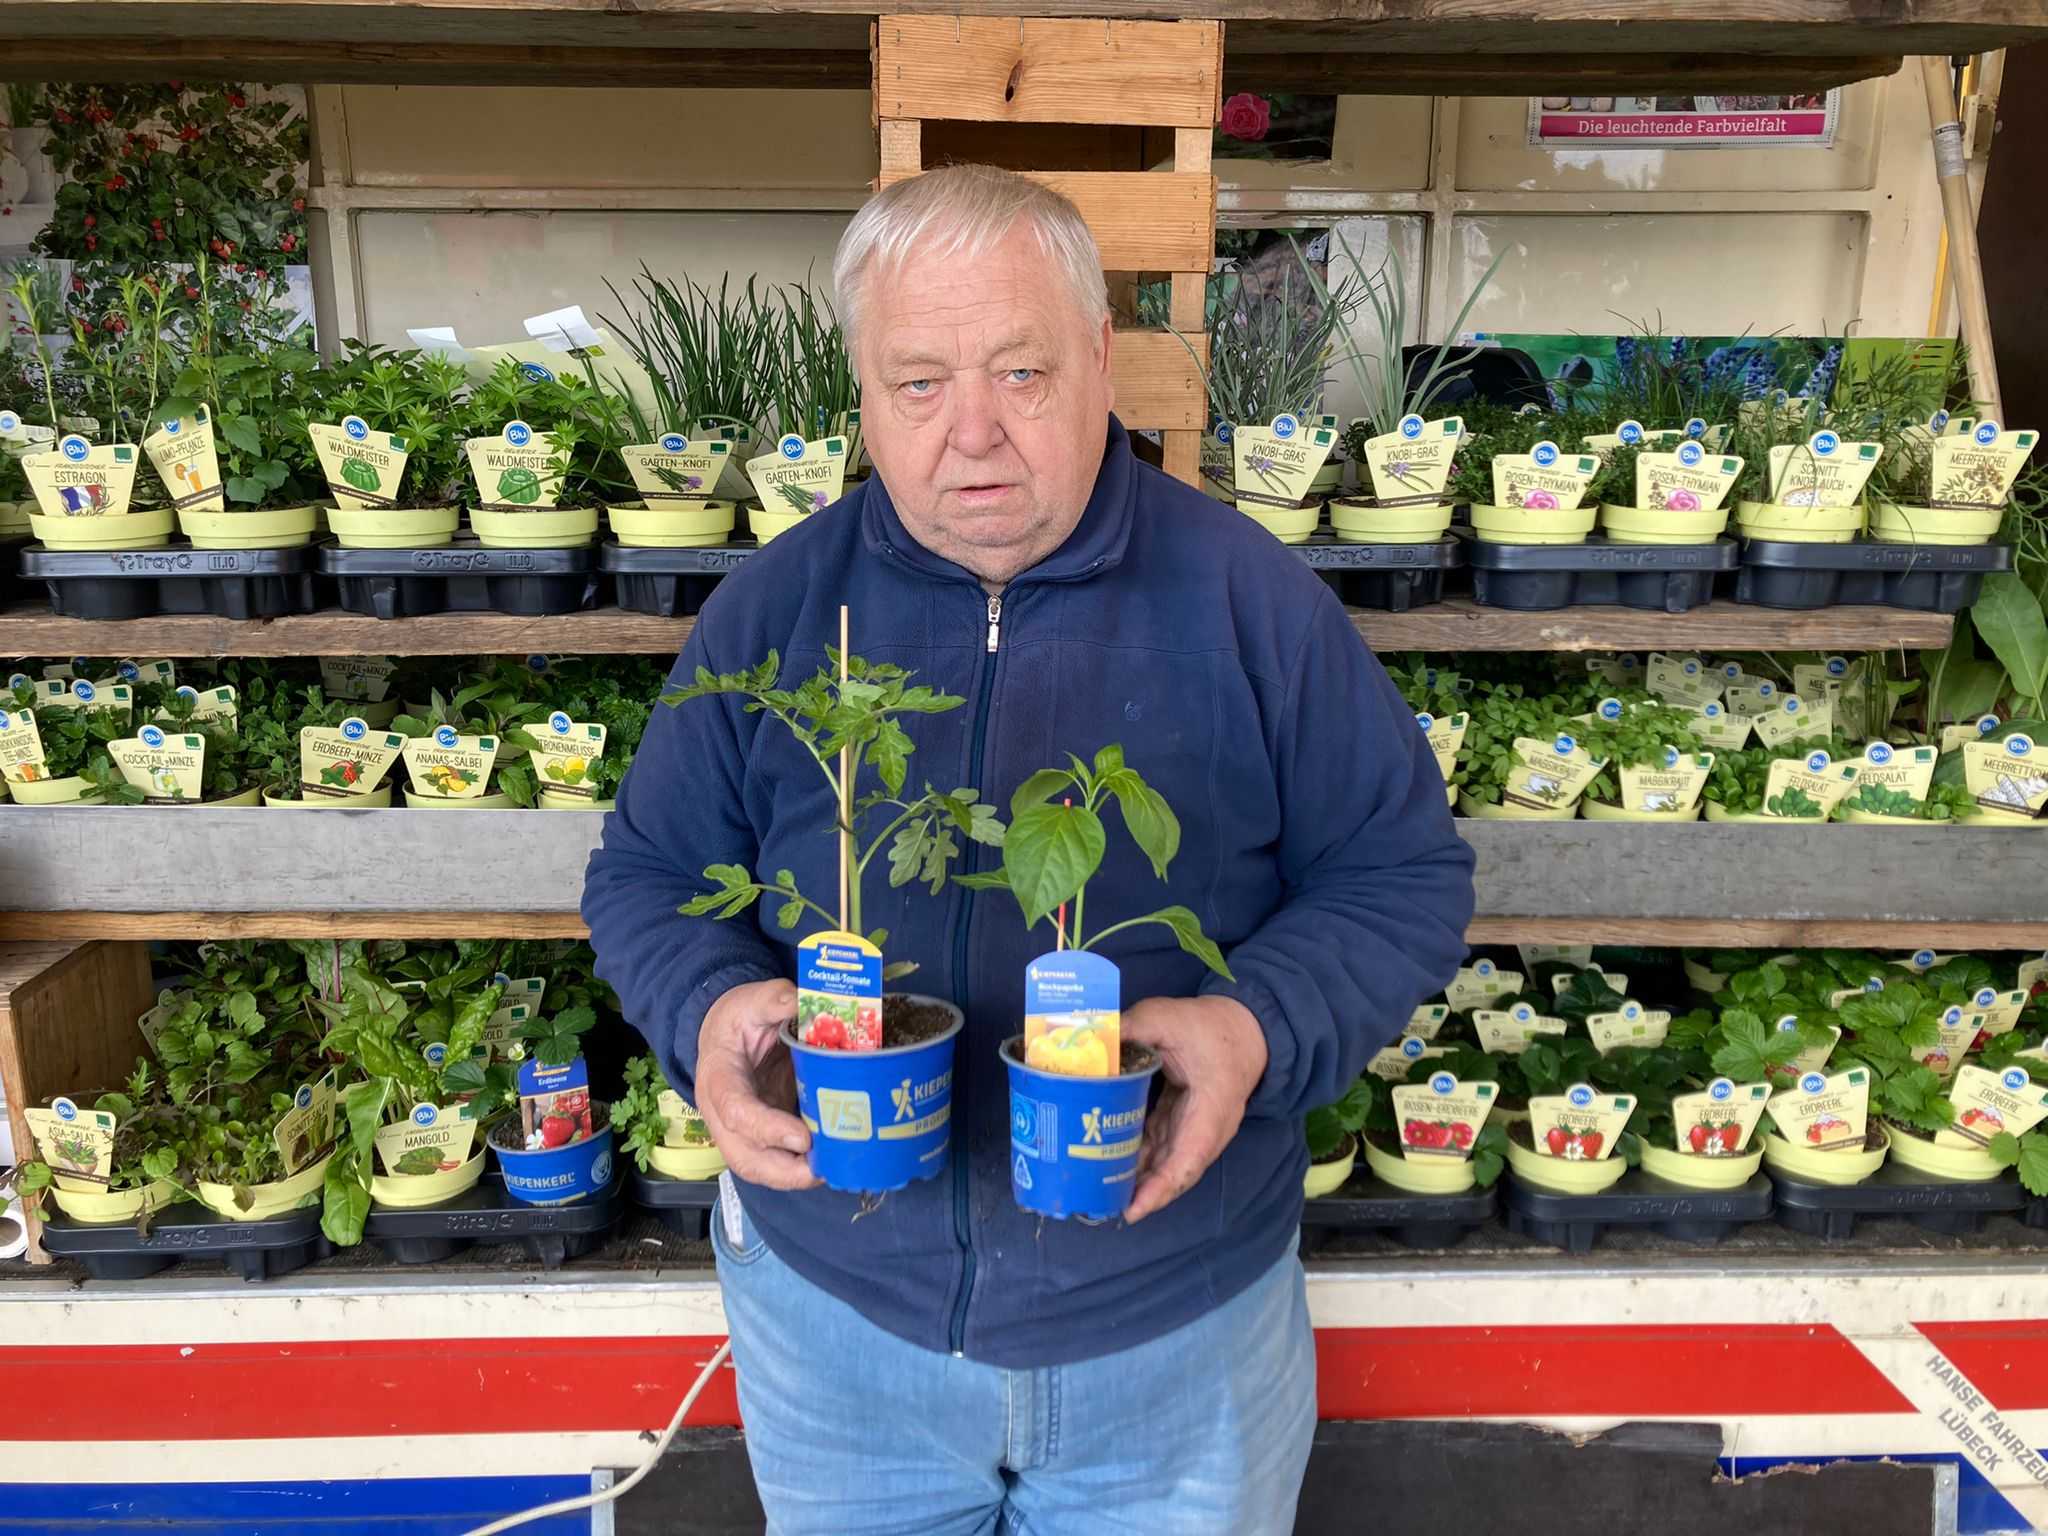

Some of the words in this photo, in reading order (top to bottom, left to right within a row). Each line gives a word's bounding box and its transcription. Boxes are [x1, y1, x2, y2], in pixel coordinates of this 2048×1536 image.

[1578, 120, 1605, 135] Die
[1607, 119, 1693, 135] leuchtende
[1697, 118, 1787, 134] Farbvielfalt
[348, 423, 365, 434] Blu
[1277, 422, 1293, 433] Blu
[1404, 421, 1420, 433] Blu
[509, 429, 527, 441] Blu
[1979, 428, 1995, 440] Blu
[66, 444, 85, 456] Blu
[159, 434, 207, 463] LIMO-PFLANZE
[666, 439, 683, 449] Blu
[784, 443, 802, 455] Blu
[1817, 439, 1834, 450] Blu
[328, 440, 391, 467] WALDMEISTER
[1251, 443, 1307, 464] KNOBI-GRAS
[1386, 445, 1440, 462] KNOBI-GRAS
[1536, 450, 1554, 460] Blu
[1682, 450, 1699, 461] Blu
[640, 457, 712, 469] GARTEN-KNOFI
[1950, 452, 2008, 469] MEERFENCHEL
[54, 471, 107, 484] ESTRAGON
[765, 465, 833, 485] GARTEN-KNOFI
[1648, 469, 1721, 493] ROSEN-THYMIAN
[1504, 471, 1579, 493] ROSEN-THYMIAN
[347, 725, 362, 735] Blu
[554, 719, 568, 730] Blu
[147, 732, 161, 744] Blu
[312, 740, 384, 764] ERDBEER-MINZE
[538, 738, 596, 757] TRONENMELISSE
[2010, 741, 2028, 751] Blu
[415, 752, 482, 769] ANANAS-SALBEI
[1871, 749, 1890, 760] Blu
[122, 753, 196, 769] COCKTAIL-MINZE
[1811, 757, 1827, 768] Blu
[1858, 771, 1908, 785] FELDSALAT
[807, 968, 872, 987] Cocktail-Tomate
[1805, 1079, 1822, 1090] Blu
[2007, 1074, 2024, 1086] Blu
[1714, 1086, 1729, 1097] Blu
[1800, 1097, 1843, 1116] ERDBEERE
[416, 1111, 434, 1122] Blu
[48, 1126, 97, 1144] ASIA-SALAT
[404, 1131, 450, 1148] MANGOLD
[1925, 1355, 1984, 1413] HANSE
[1938, 1408, 2003, 1472] LÜBECK
